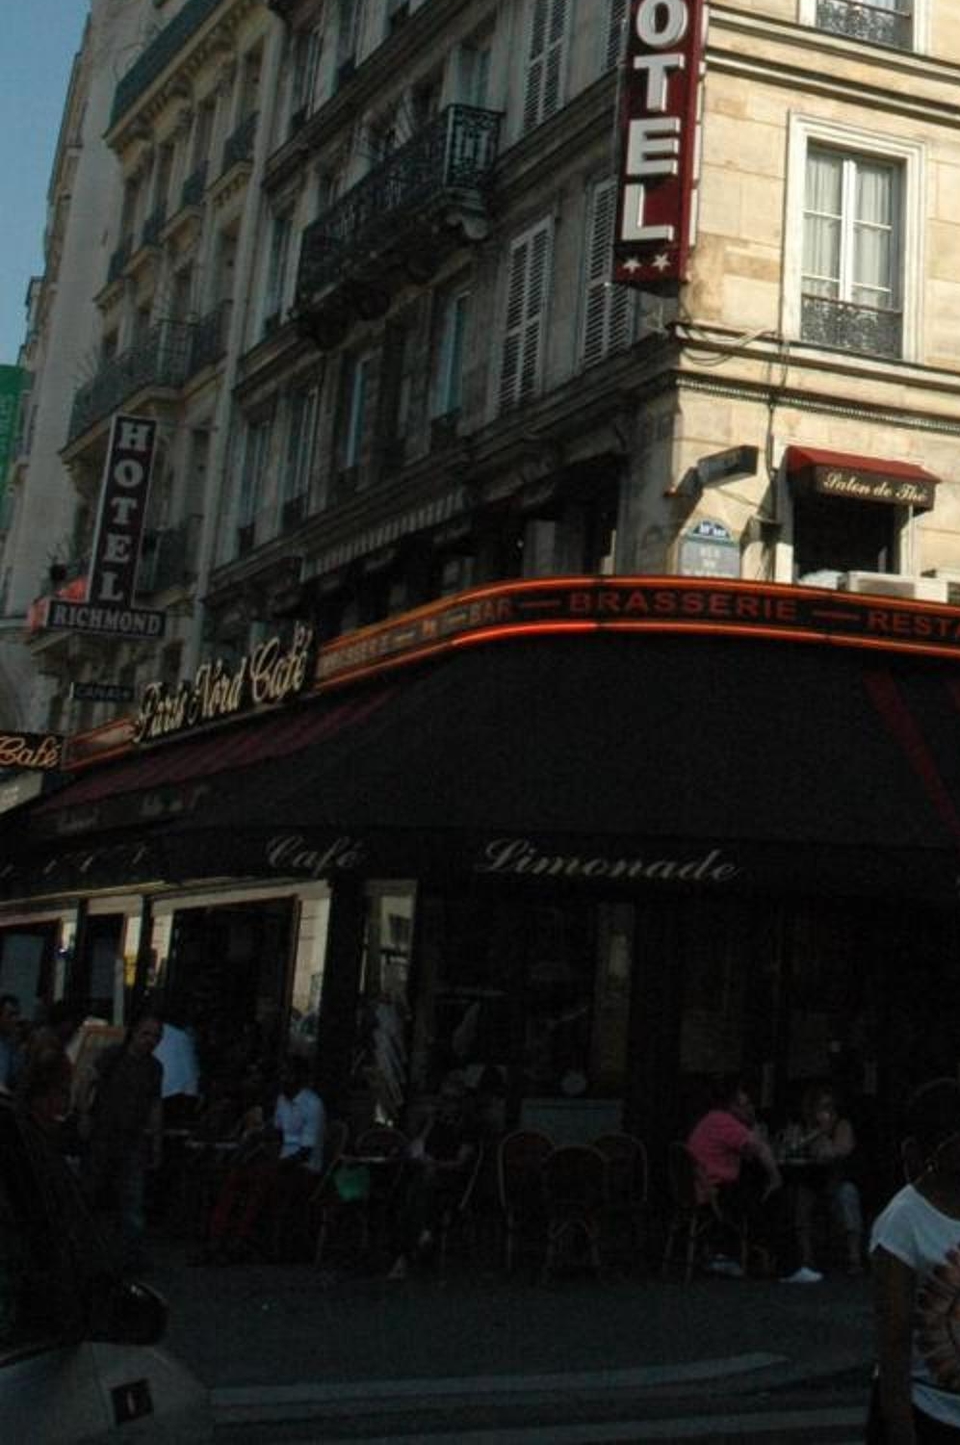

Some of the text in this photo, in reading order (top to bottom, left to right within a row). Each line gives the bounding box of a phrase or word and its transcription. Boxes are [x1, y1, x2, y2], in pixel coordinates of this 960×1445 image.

[823, 471, 872, 496] Salon
[873, 480, 893, 499] de
[99, 421, 154, 603] HOTEL
[53, 604, 161, 636] RICHMOND
[569, 591, 797, 622] BRASSERIE
[185, 658, 248, 724] Nord
[249, 623, 315, 703] Café
[0, 736, 61, 769] Café
[265, 835, 370, 878] Café
[481, 838, 741, 884] Limonade
